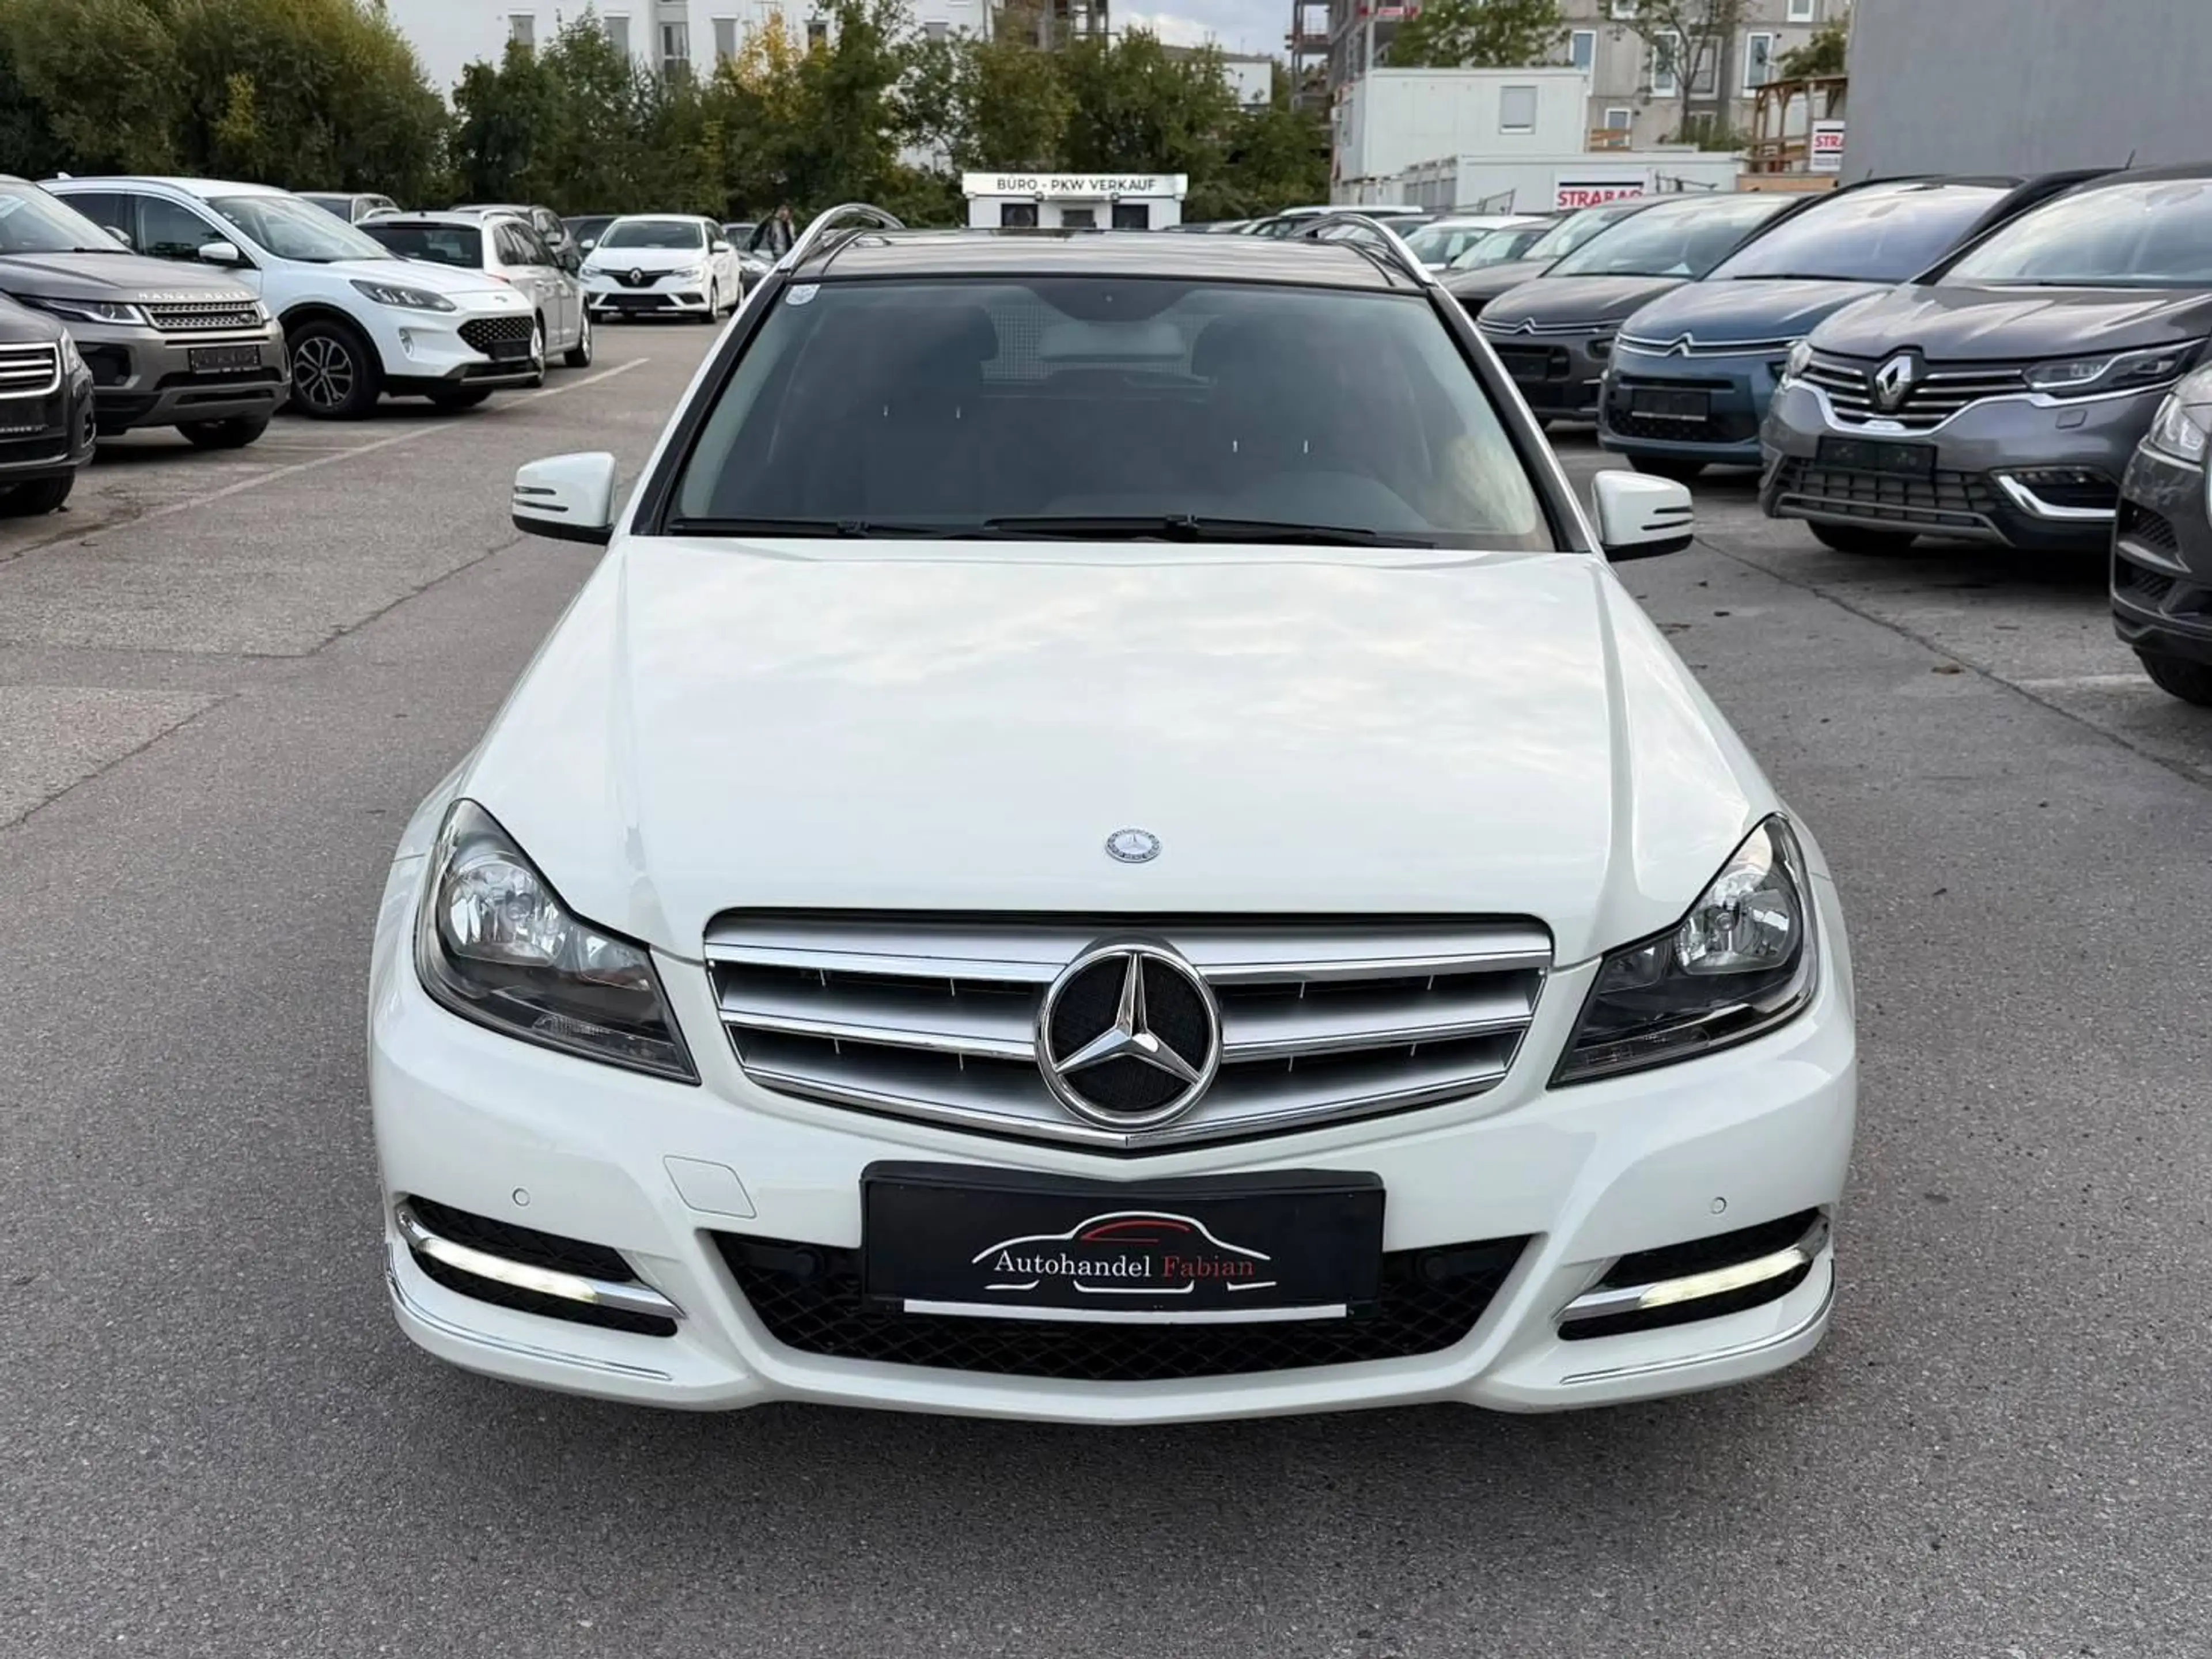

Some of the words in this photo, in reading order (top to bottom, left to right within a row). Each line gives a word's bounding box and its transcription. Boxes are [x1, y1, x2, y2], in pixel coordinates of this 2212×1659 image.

[997, 176, 1037, 190] BÜRO
[1051, 179, 1085, 190] PKW
[1089, 178, 1156, 191] VERKAUF
[994, 1249, 1152, 1278] Autohandel
[1162, 1255, 1254, 1278] Fabian
